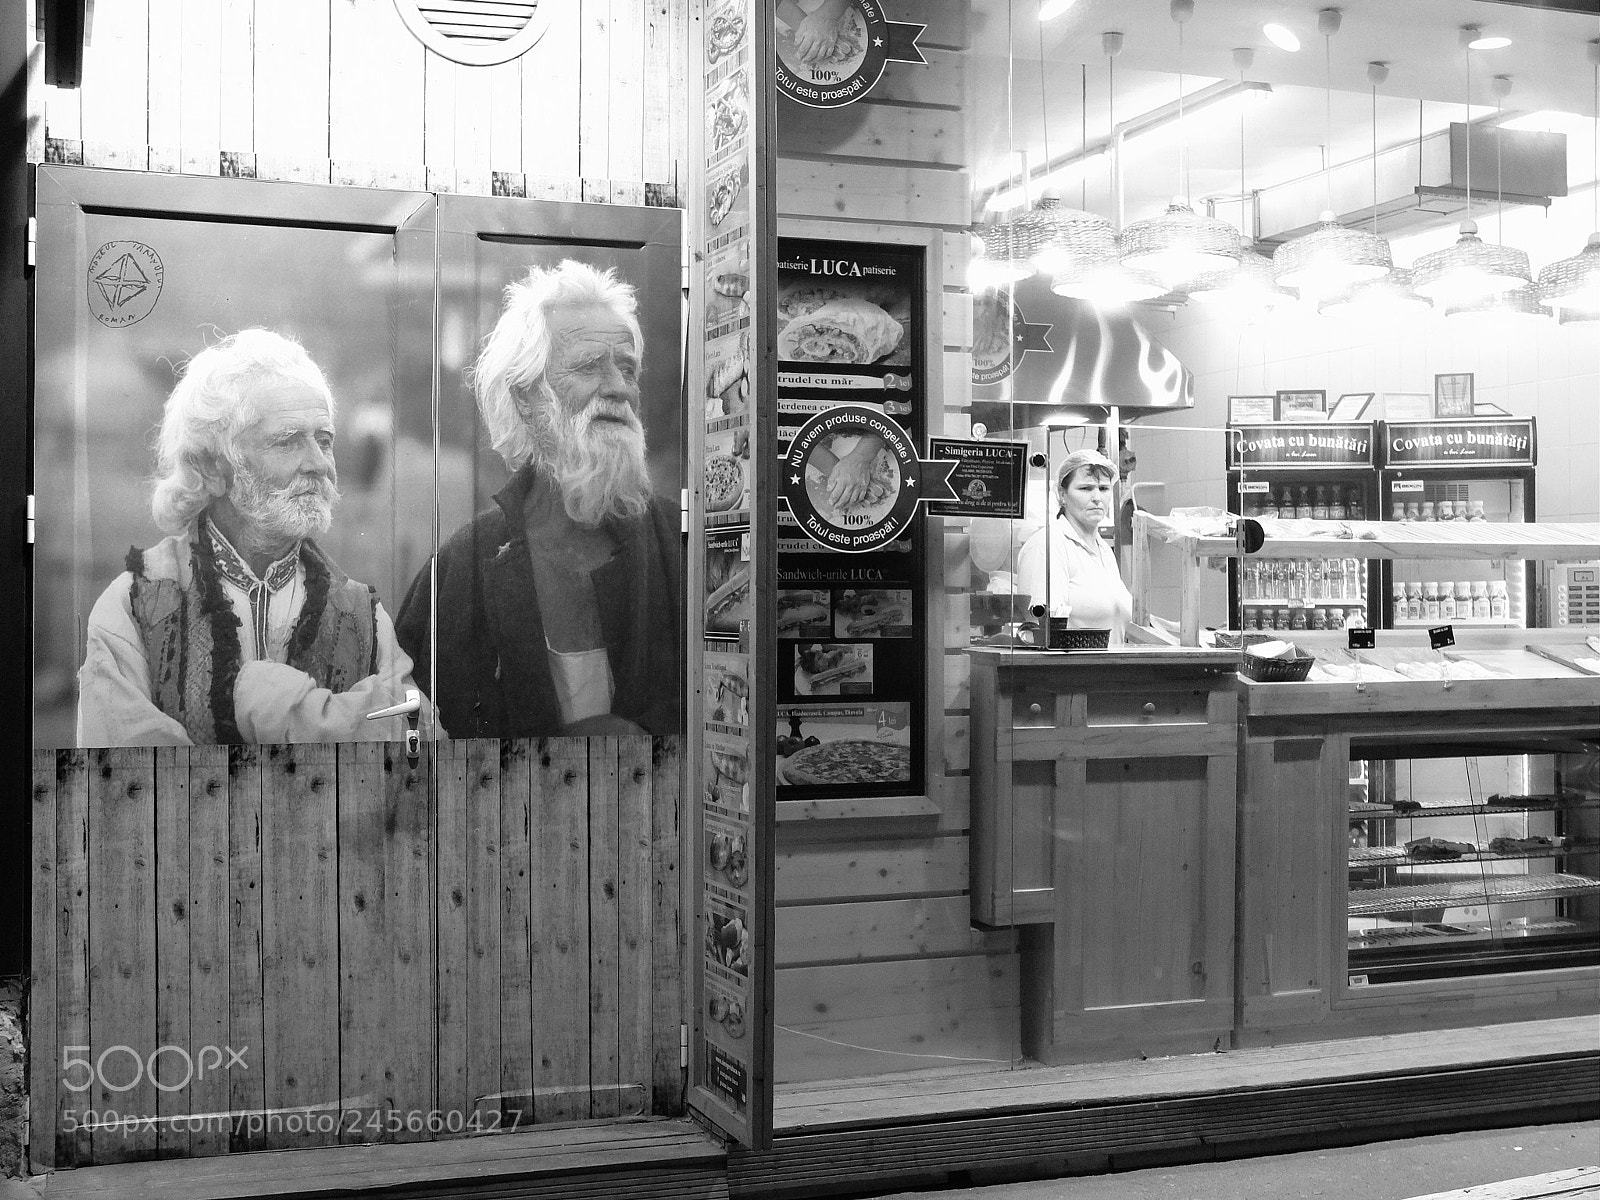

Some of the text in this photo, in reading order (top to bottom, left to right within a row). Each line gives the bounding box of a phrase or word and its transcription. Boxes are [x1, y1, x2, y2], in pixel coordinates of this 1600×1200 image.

[810, 69, 842, 82] 100%
[776, 67, 797, 91] Totul
[796, 86, 818, 99] este
[820, 79, 863, 102] proaspăt
[809, 259, 862, 277] LUCA
[863, 265, 896, 276] patiserie
[778, 375, 811, 385] trudel
[885, 374, 896, 388] 2
[899, 379, 910, 387] lei
[778, 402, 817, 411] erdenea
[885, 401, 896, 412] 3
[790, 449, 804, 468] NU
[801, 424, 825, 449] avem
[825, 413, 867, 430] produse
[869, 419, 907, 458] congelate
[1237, 435, 1285, 453] Covata
[1289, 436, 1305, 447] cu
[1393, 434, 1443, 452] Covata
[1446, 433, 1463, 444] cu
[945, 446, 983, 458] Simigeria
[986, 448, 1012, 458] LUCA
[842, 514, 874, 526] 100%
[806, 514, 829, 534] Totul
[828, 531, 851, 545] este
[853, 520, 895, 547] proaspăt
[778, 541, 809, 550] trudel
[777, 568, 883, 580] Sandwich-urile LUCA
[878, 711, 886, 726] 4
